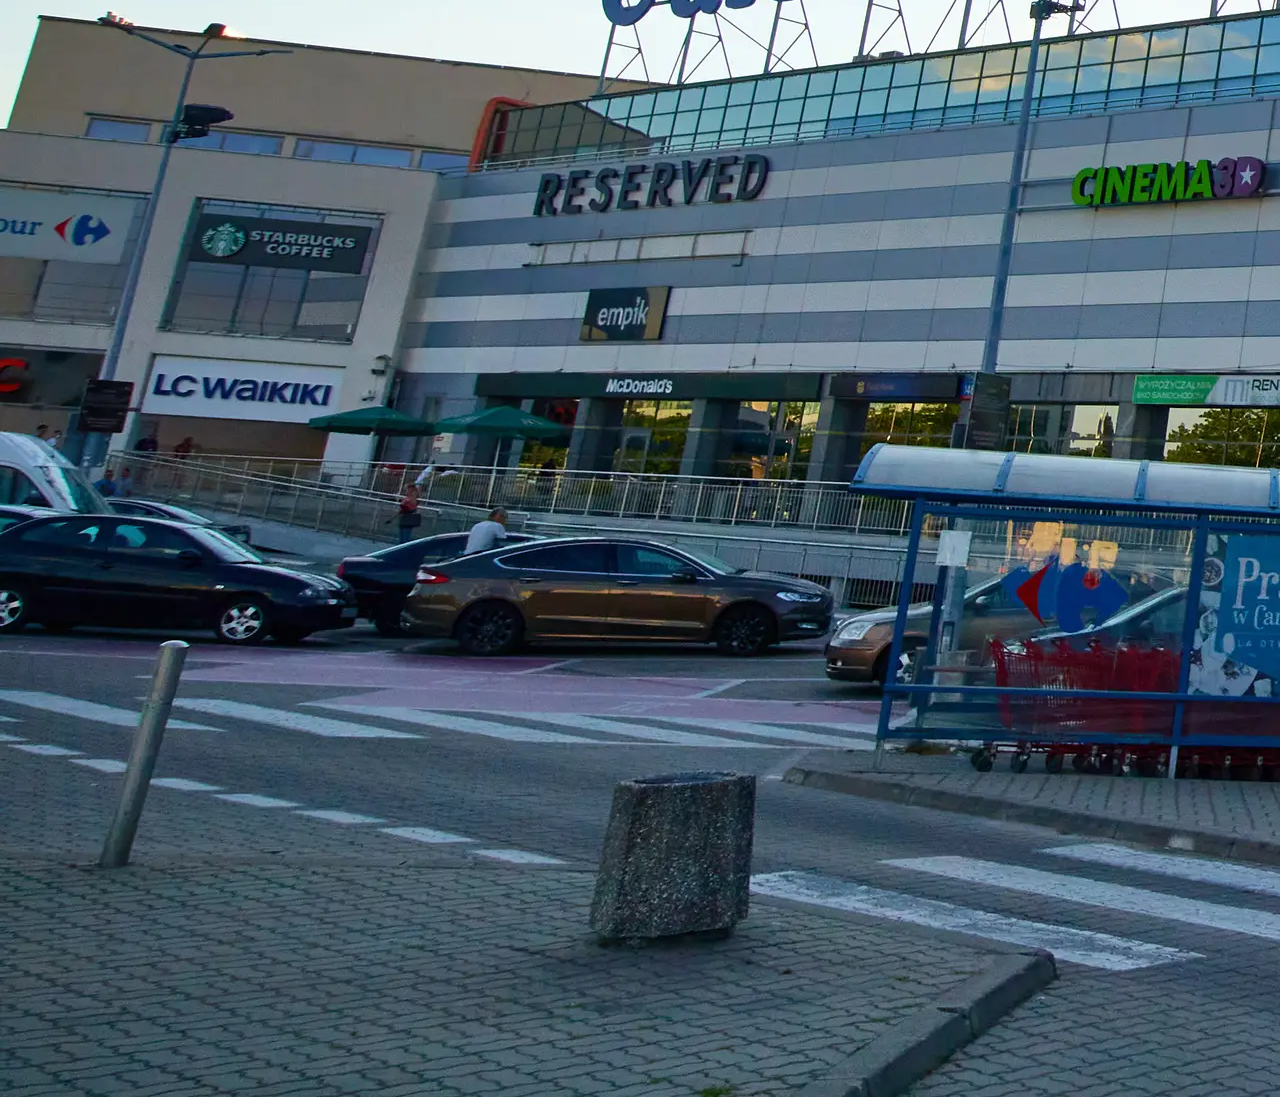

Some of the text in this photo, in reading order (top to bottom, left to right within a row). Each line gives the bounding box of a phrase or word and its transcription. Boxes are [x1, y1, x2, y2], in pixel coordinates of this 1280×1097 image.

[532, 154, 770, 216] RESERVED
[250, 230, 357, 249] STARBUCKS
[266, 243, 334, 259] COFFEE
[597, 296, 650, 330] empik
[152, 373, 199, 399] LC
[606, 378, 673, 393] McDonald's
[1233, 610, 1248, 624] w
